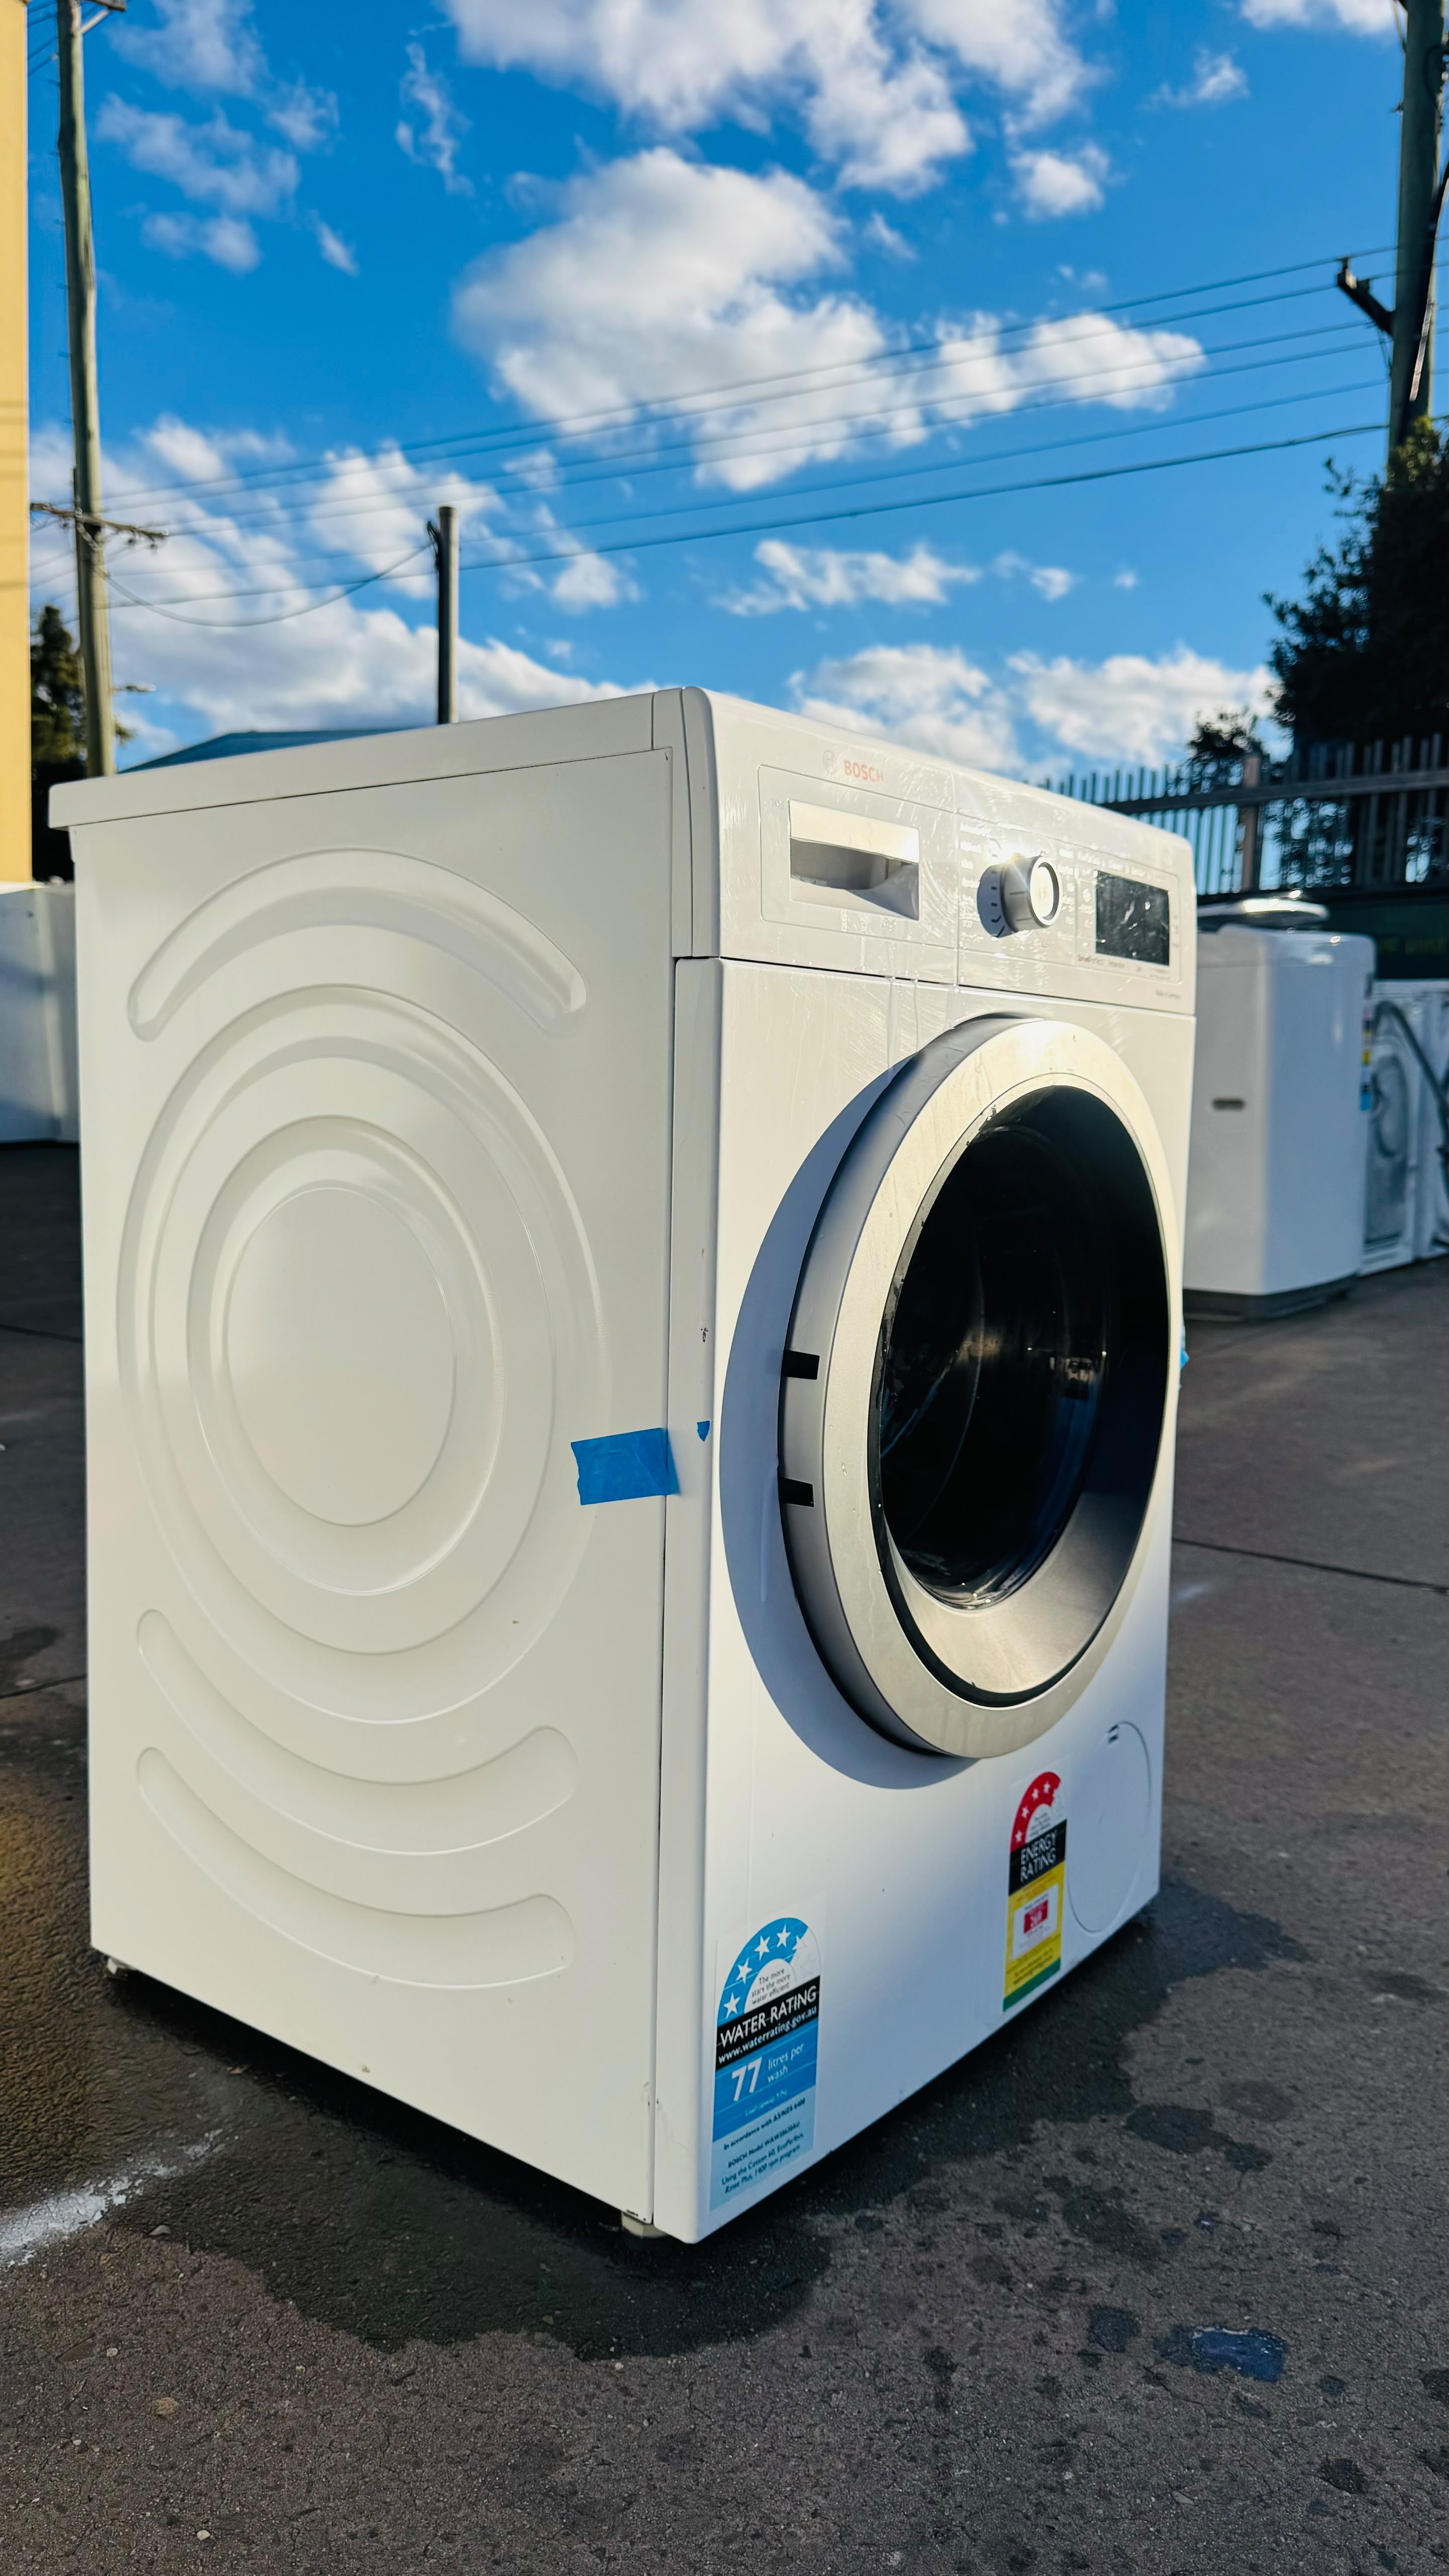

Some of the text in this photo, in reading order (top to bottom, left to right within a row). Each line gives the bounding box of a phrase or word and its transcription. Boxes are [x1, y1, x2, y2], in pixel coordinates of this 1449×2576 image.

[844, 759, 884, 782] BOSCH
[1020, 1829, 1057, 1866] ENERGY
[1020, 1847, 1056, 1883] RATING
[718, 2006, 817, 2064] www.waterrating.gov.au
[720, 1985, 816, 2048] WATER RATING
[731, 2056, 762, 2102] 77
[768, 2052, 788, 2071] litres
[790, 2043, 805, 2061] per
[767, 2065, 788, 2083] wash
